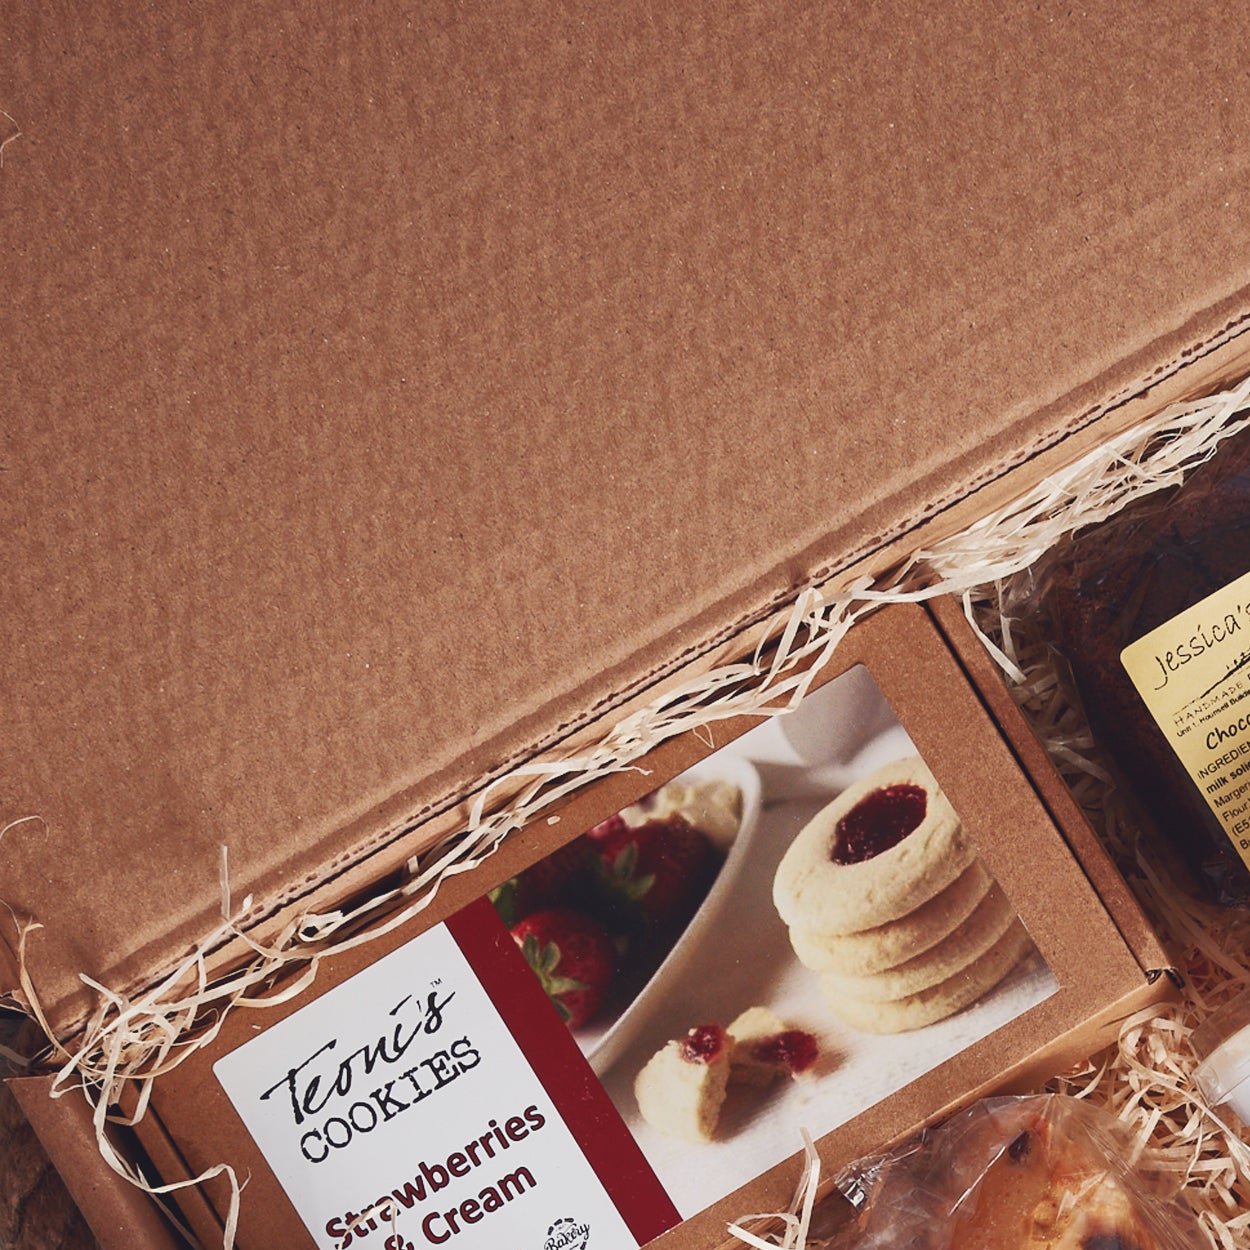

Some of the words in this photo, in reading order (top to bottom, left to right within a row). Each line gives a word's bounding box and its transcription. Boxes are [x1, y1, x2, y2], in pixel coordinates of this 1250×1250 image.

[1174, 682, 1244, 727] HANDMADE
[1206, 776, 1229, 794] milk
[260, 990, 456, 1125] Teoni's
[300, 1036, 481, 1163] COOKIES
[326, 1105, 545, 1250] Strawberries
[422, 1166, 537, 1245] Cream
